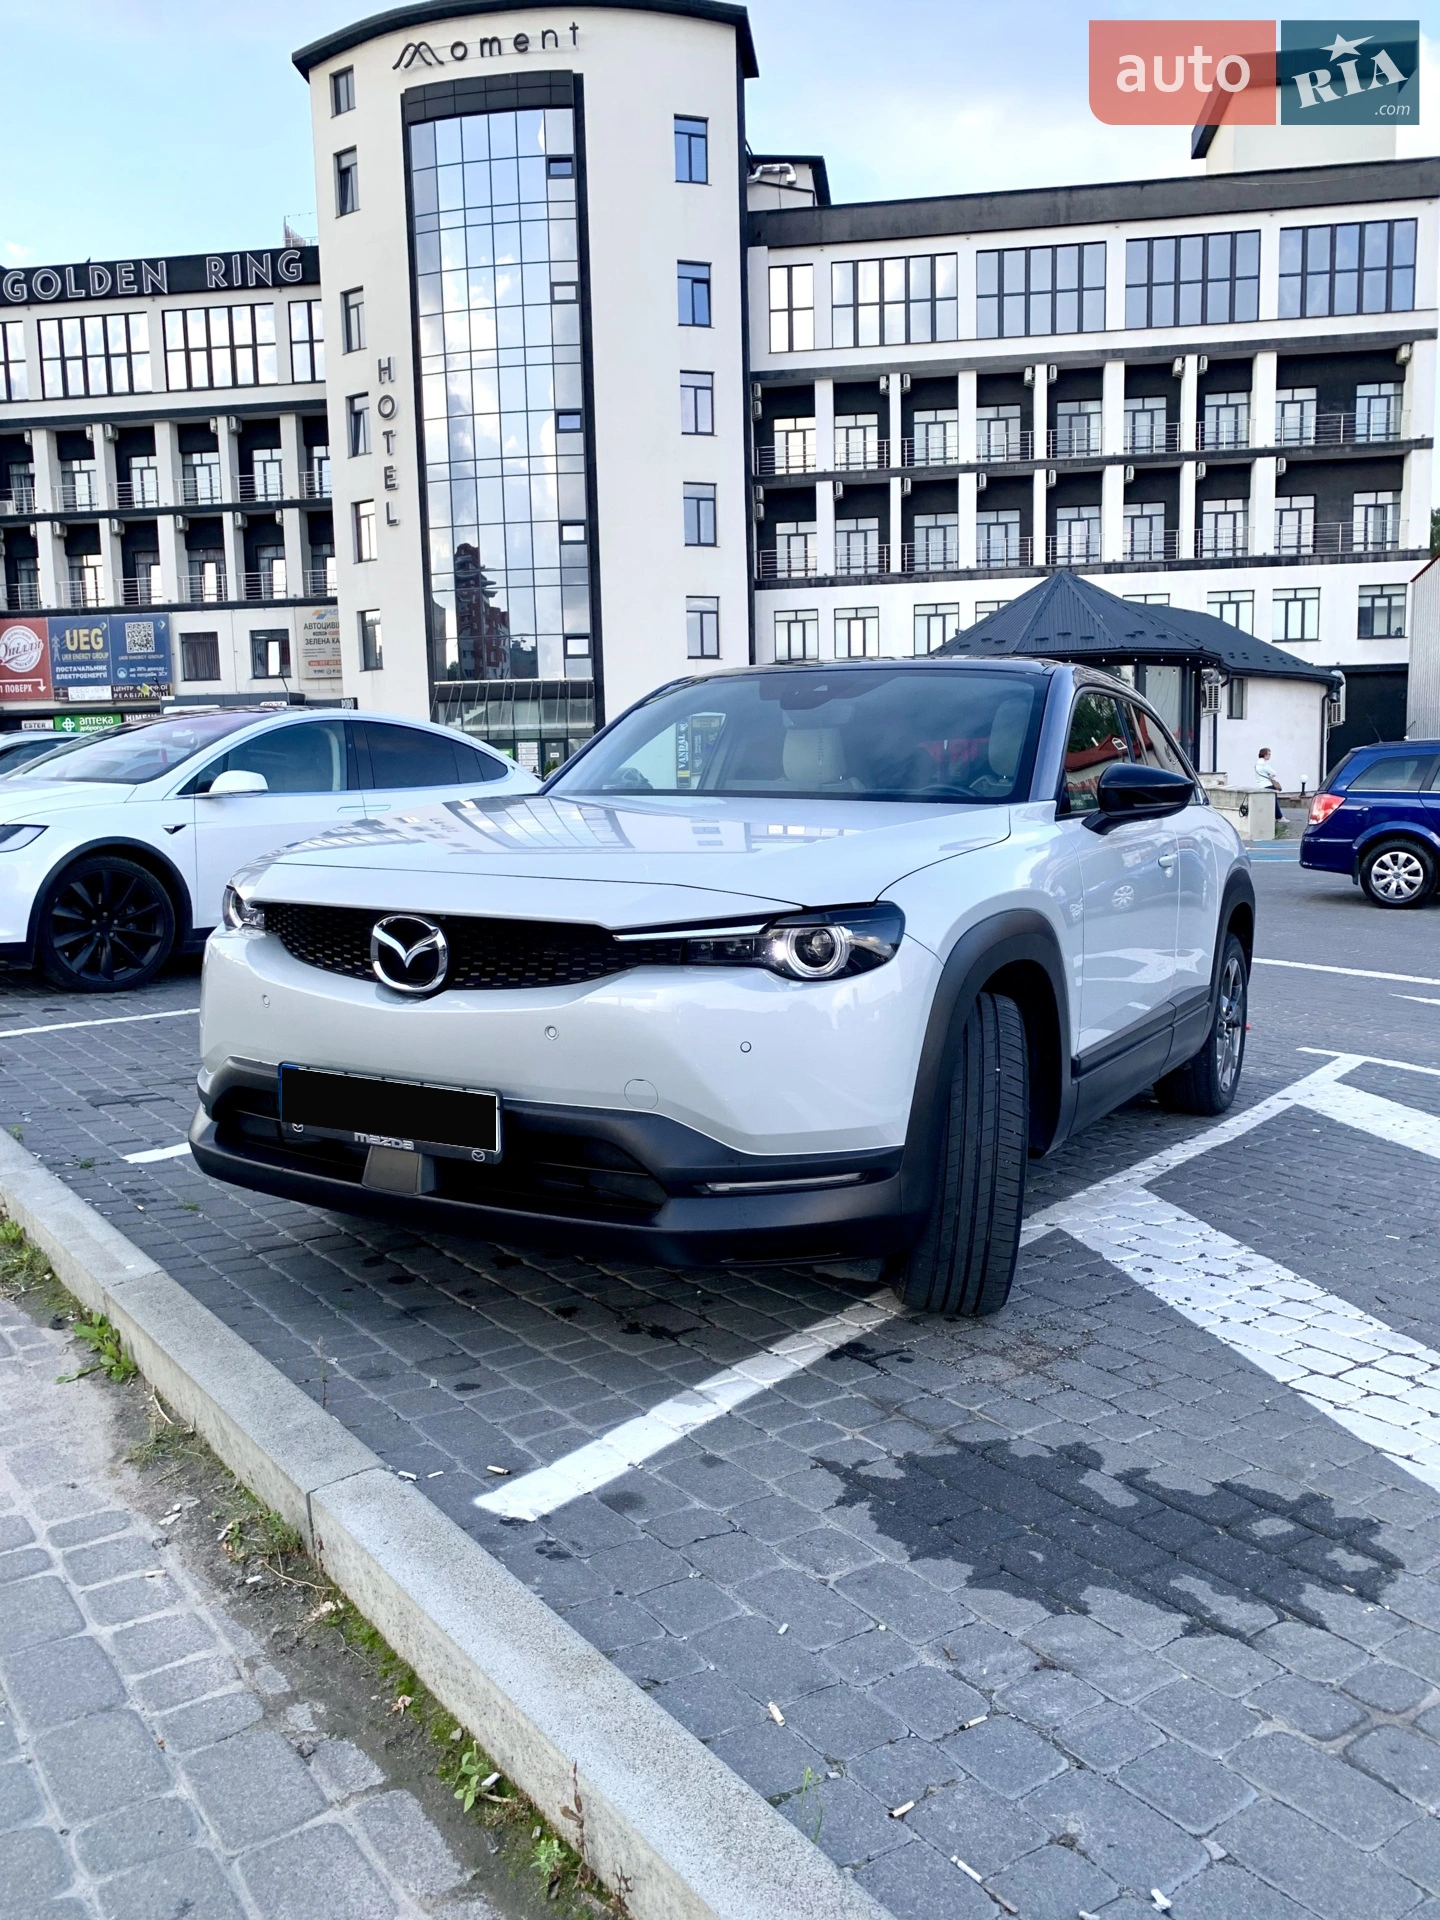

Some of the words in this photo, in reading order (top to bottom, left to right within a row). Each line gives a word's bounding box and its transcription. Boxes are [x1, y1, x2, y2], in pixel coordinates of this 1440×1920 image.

[2, 260, 168, 303] GOLDEN
[206, 249, 303, 288] RING
[377, 356, 400, 527] HOTEL
[303, 622, 340, 631] АВТОЦИВІ
[65, 628, 104, 651] UEG
[305, 638, 331, 646] ЗЕЛЕНА
[61, 653, 71, 661] UKR
[72, 652, 91, 661] ENERGY
[92, 652, 109, 660] GROUP
[56, 672, 107, 680] ЕЛЕКТРОЕНЕРГІЇ
[5, 684, 32, 693] ПОВЕРХ
[79, 716, 114, 725] аптека
[678, 734, 686, 768] VANDAL
